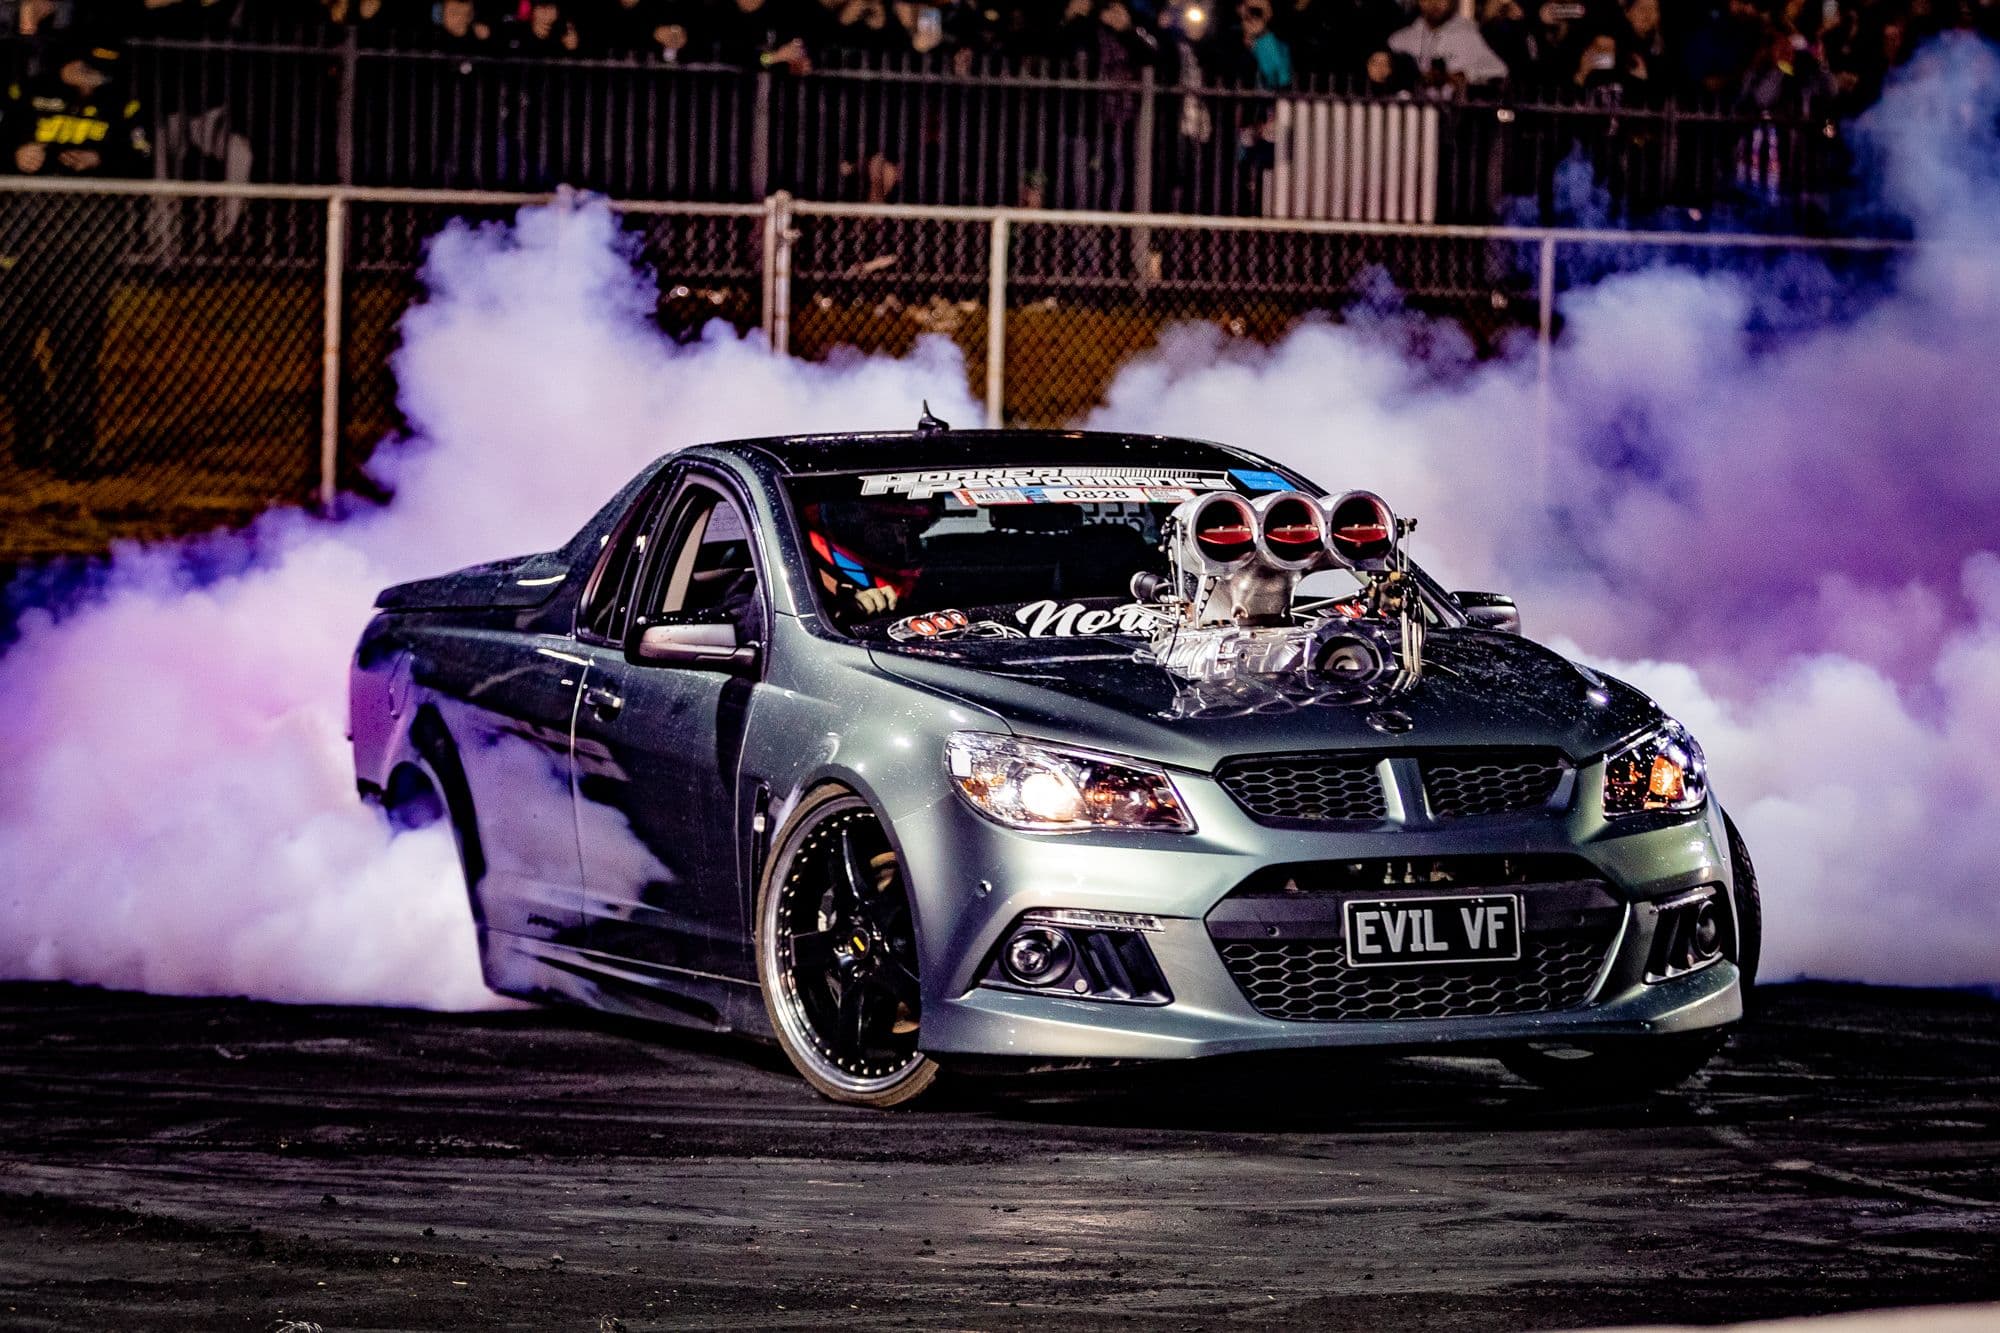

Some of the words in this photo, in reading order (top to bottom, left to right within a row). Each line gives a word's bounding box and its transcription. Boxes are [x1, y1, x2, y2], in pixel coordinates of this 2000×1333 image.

[1063, 489, 1130, 500] 0828
[1356, 908, 1449, 954] EVIL
[1460, 906, 1508, 950] VF
